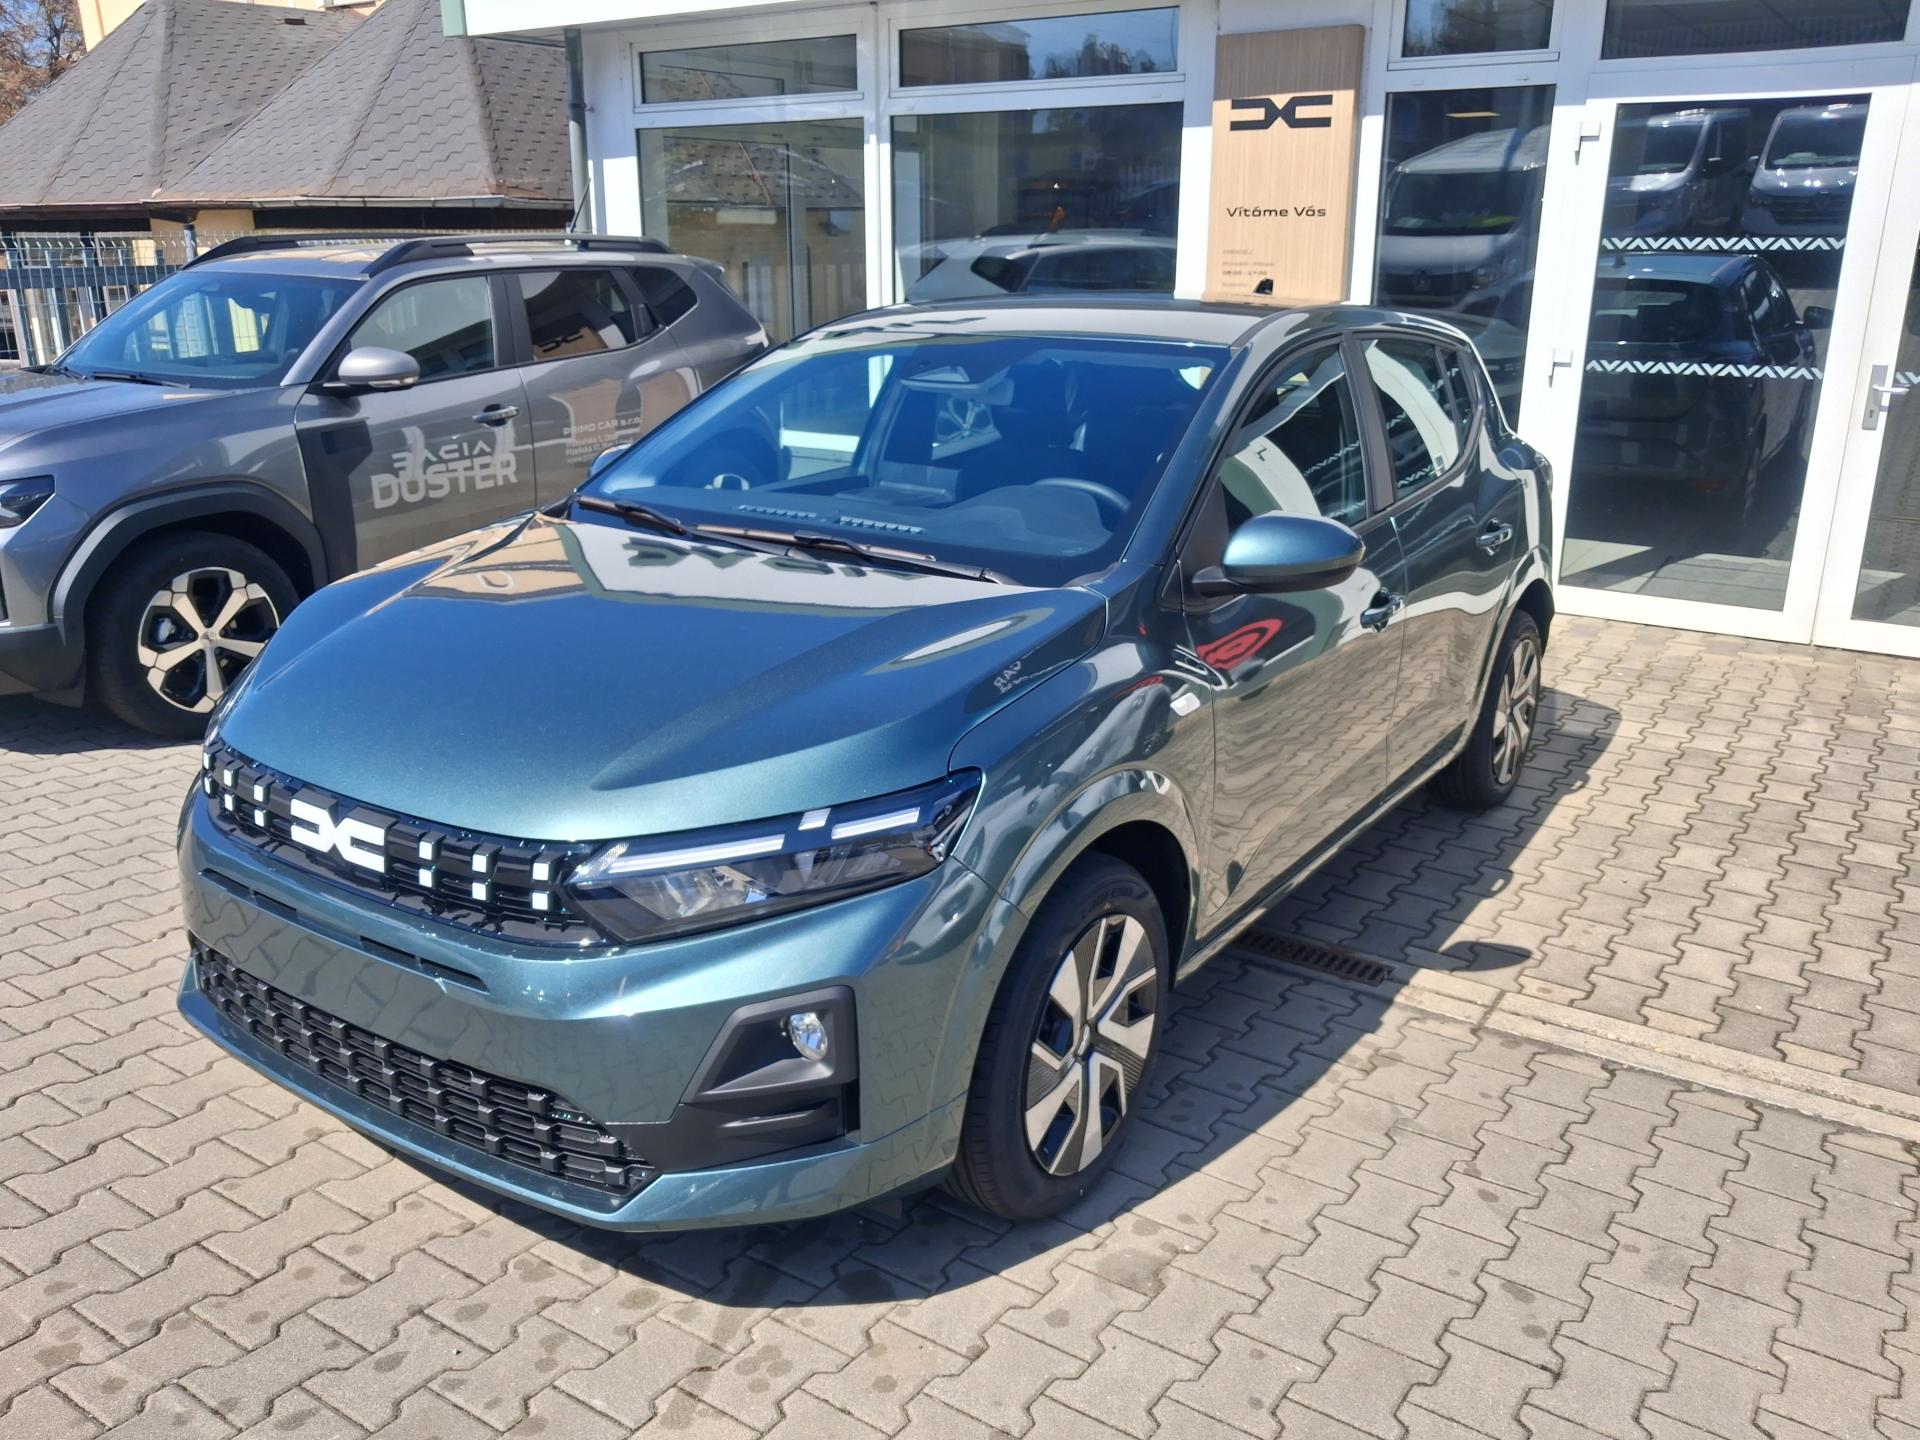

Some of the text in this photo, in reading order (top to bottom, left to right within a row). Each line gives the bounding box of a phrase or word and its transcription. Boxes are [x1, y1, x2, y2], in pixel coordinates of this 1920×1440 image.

[1226, 205, 1326, 217] Vítáme Vás
[597, 419, 618, 430] CAR
[370, 452, 518, 510] DUSTER
